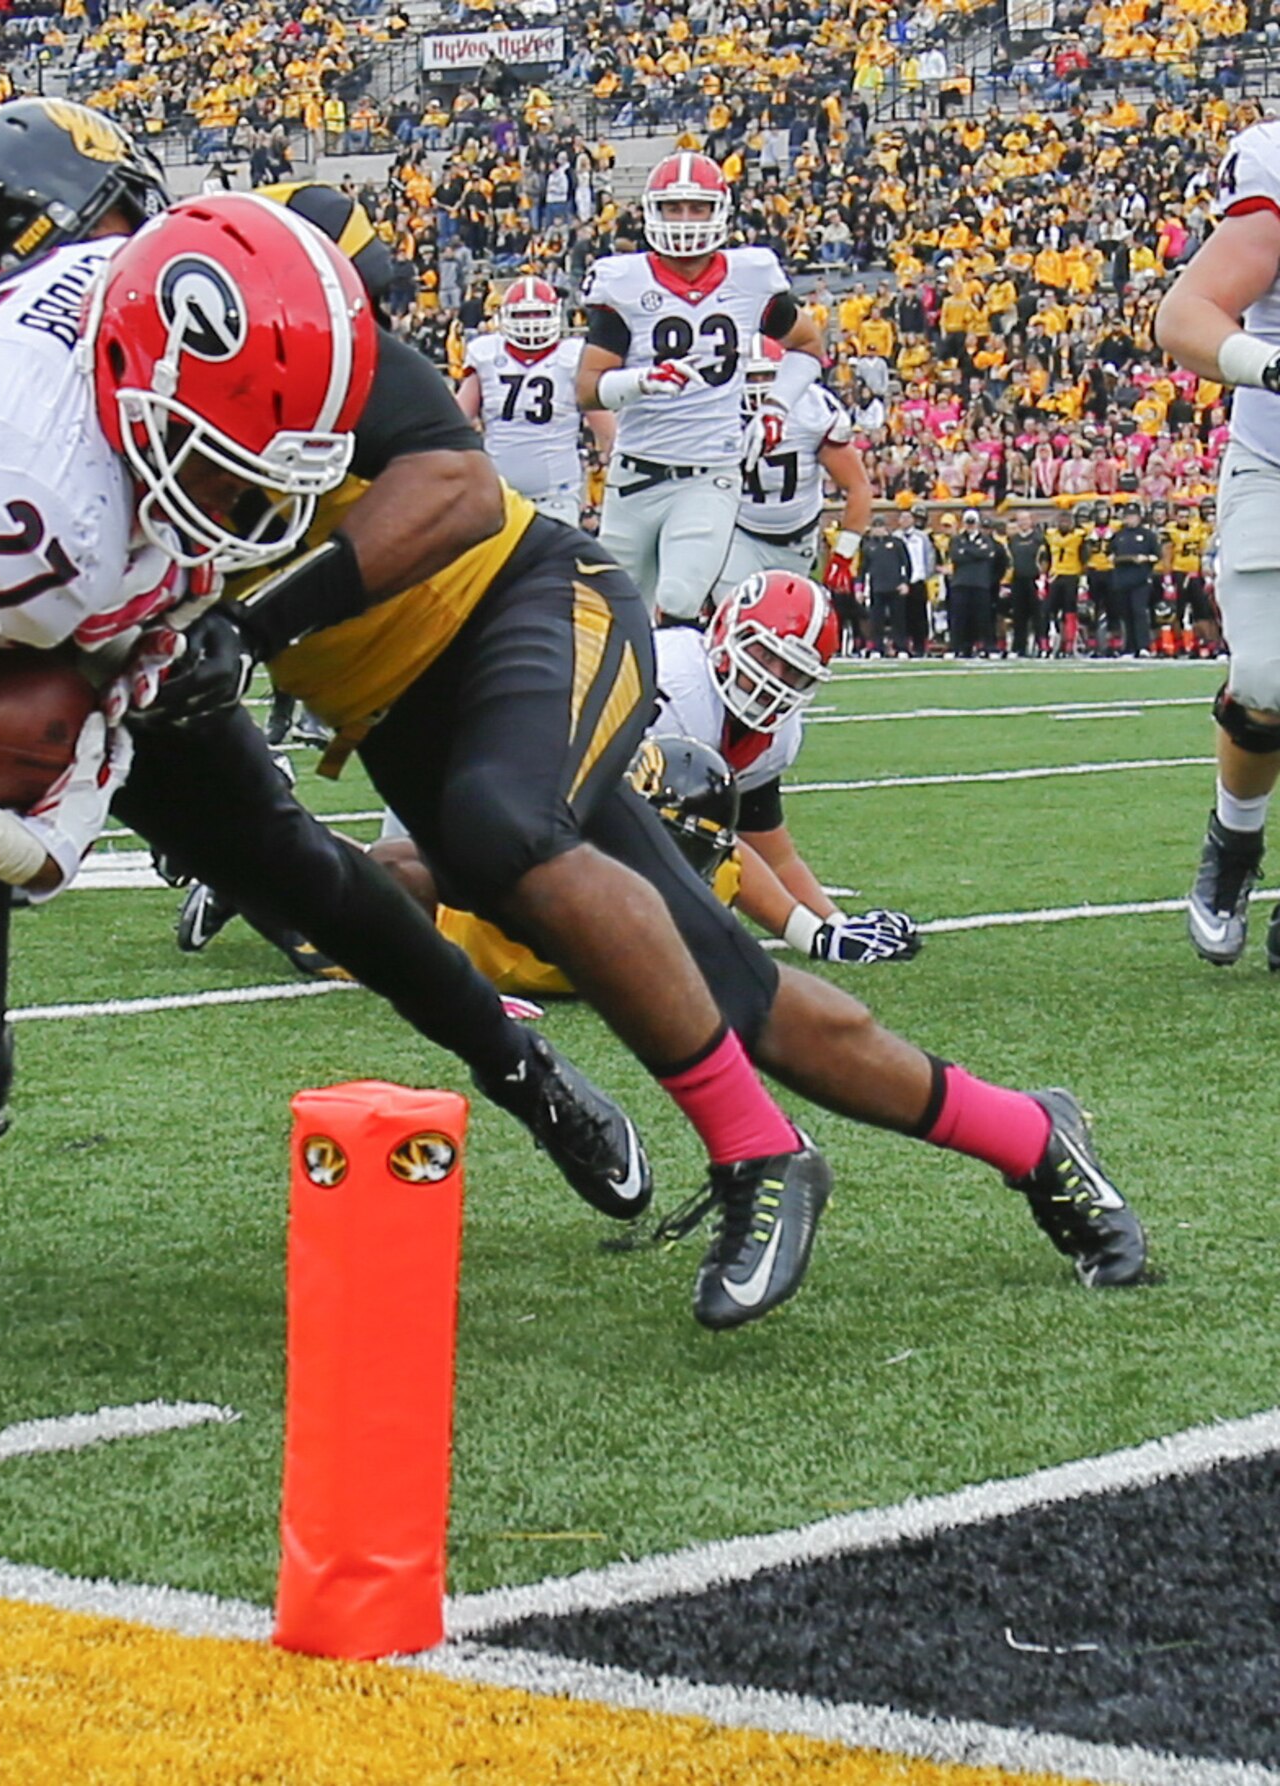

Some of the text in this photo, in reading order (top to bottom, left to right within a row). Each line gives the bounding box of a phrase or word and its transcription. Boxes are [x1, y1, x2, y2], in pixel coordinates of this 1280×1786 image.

[432, 32, 555, 63] HyVee HyVee
[652, 313, 739, 387] 83
[499, 374, 554, 424] 73
